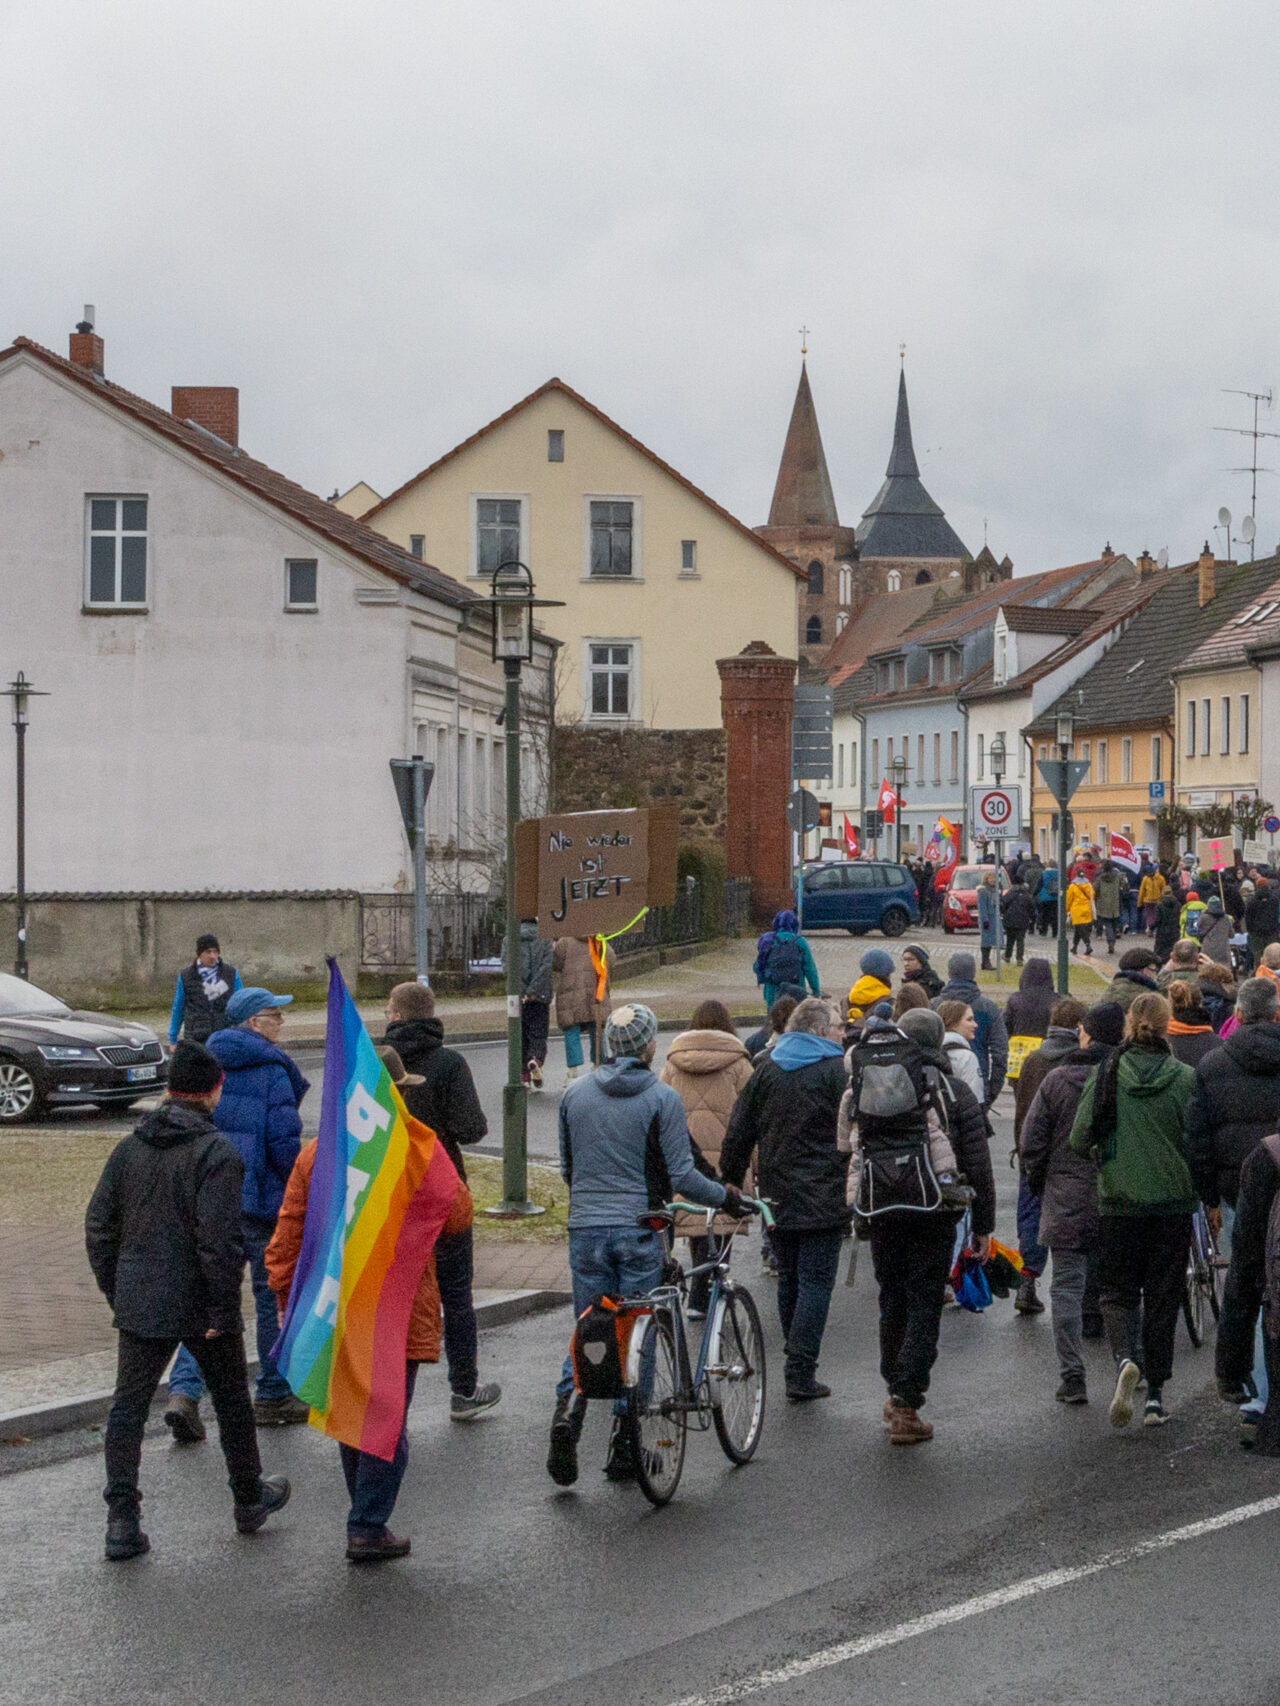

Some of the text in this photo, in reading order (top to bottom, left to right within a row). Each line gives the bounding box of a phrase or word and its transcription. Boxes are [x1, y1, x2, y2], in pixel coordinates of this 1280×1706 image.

[1152, 784, 1161, 796] P
[987, 800, 1005, 816] 30
[985, 826, 1009, 835] ZONE
[549, 830, 633, 852] Nie wieder
[579, 853, 604, 873] ist
[551, 875, 631, 922] JETZT
